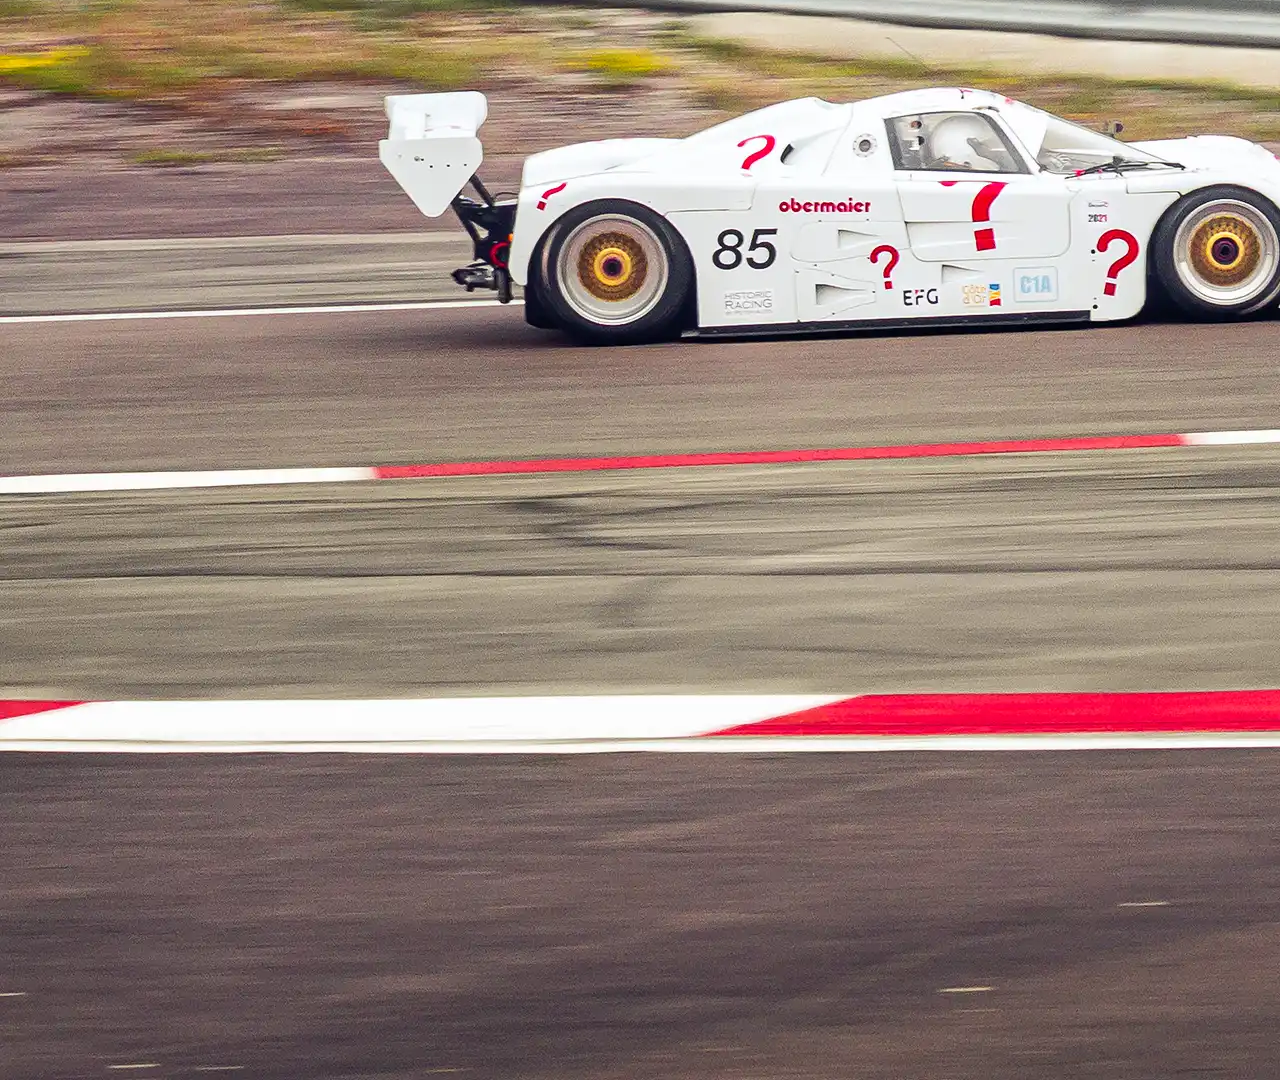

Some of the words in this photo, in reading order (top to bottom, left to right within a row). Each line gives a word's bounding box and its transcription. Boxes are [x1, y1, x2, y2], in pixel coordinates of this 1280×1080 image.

[778, 197, 871, 213] obermaier
[1088, 214, 1108, 222] 2021
[712, 228, 778, 271] 85
[1020, 275, 1051, 294] C1A
[724, 290, 772, 300] HISTORIC
[902, 288, 939, 306] EFG
[724, 298, 773, 310] RACING
